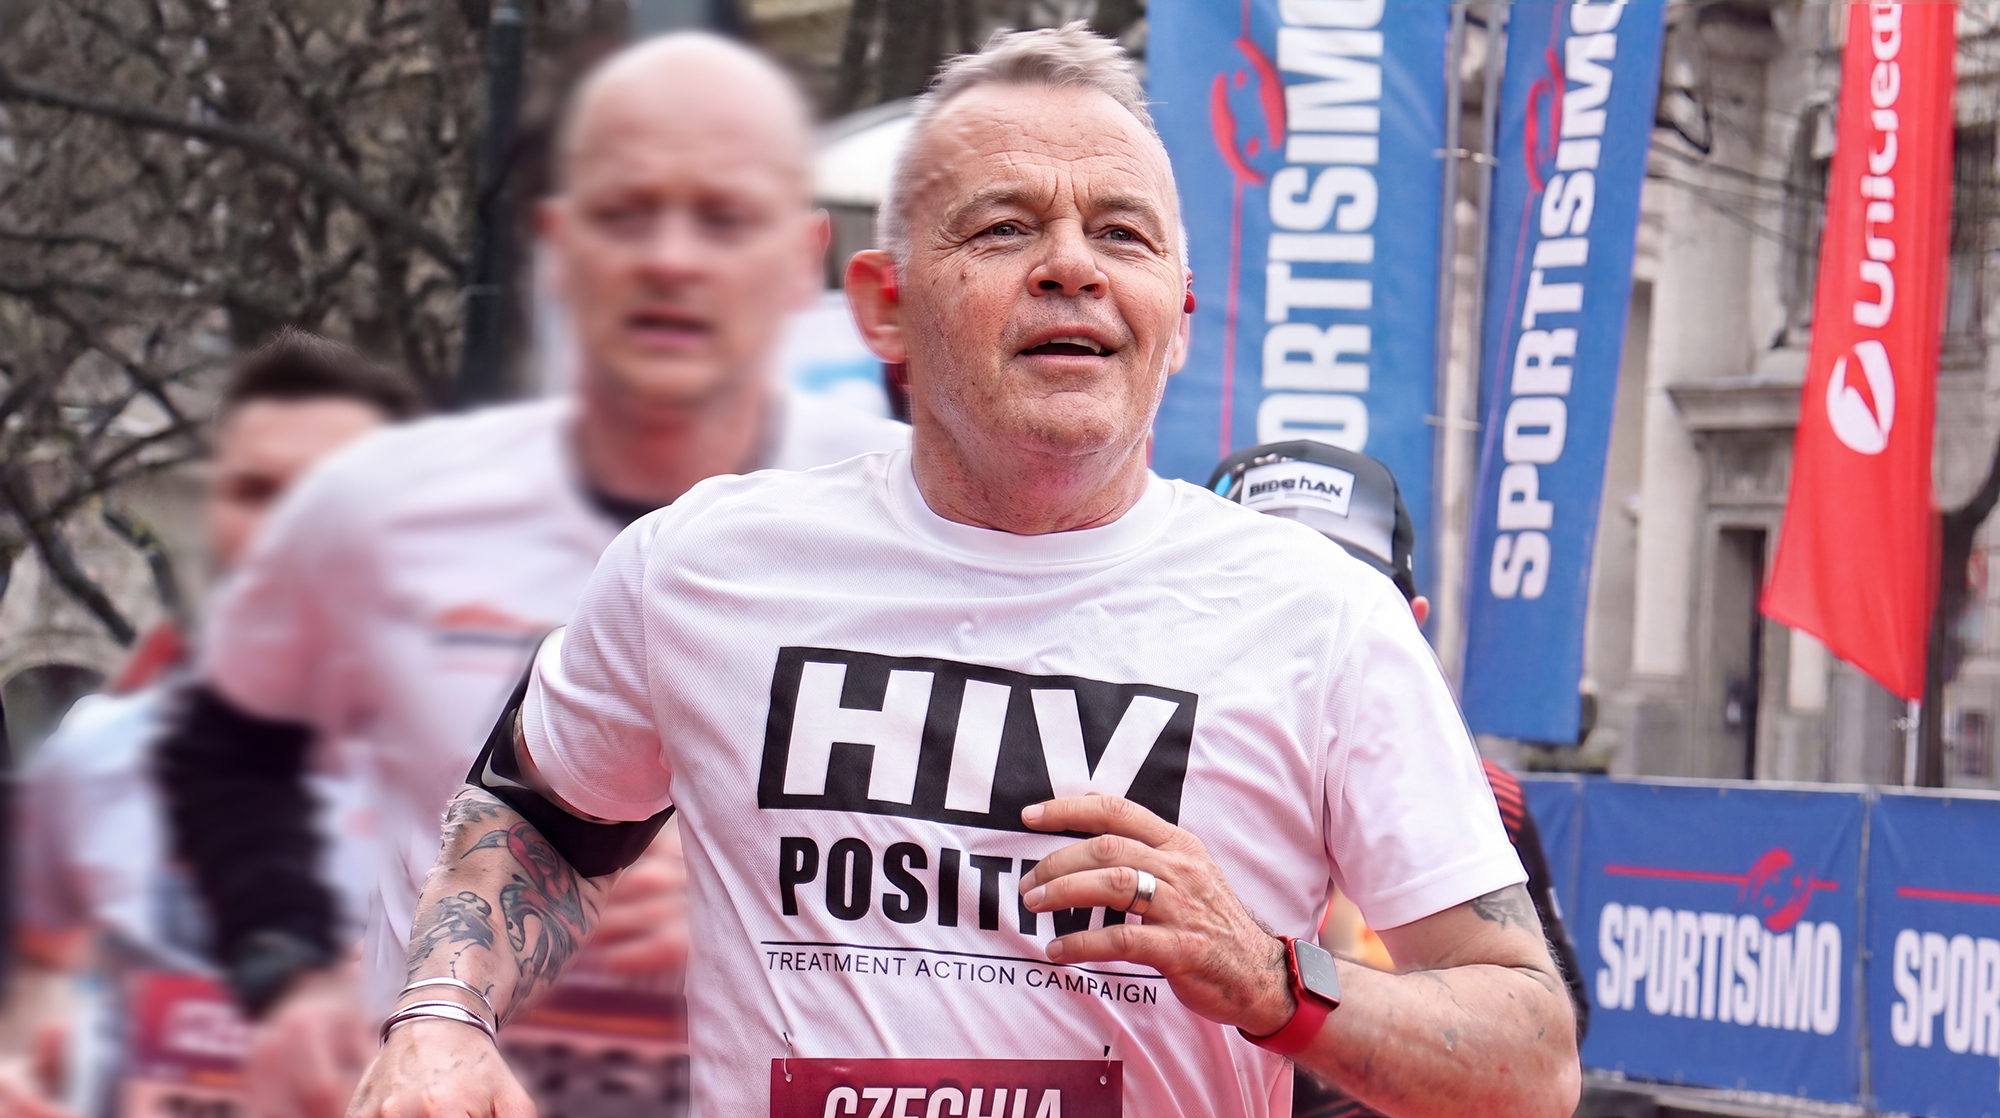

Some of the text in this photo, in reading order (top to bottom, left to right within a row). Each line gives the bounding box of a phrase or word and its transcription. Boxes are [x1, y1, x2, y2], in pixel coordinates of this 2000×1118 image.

[783, 660, 1180, 815] HIV
[766, 950, 1158, 1006] TREATMENT ACTION CAMPAIGN
[1597, 903, 1842, 1036] SPORTISIMO
